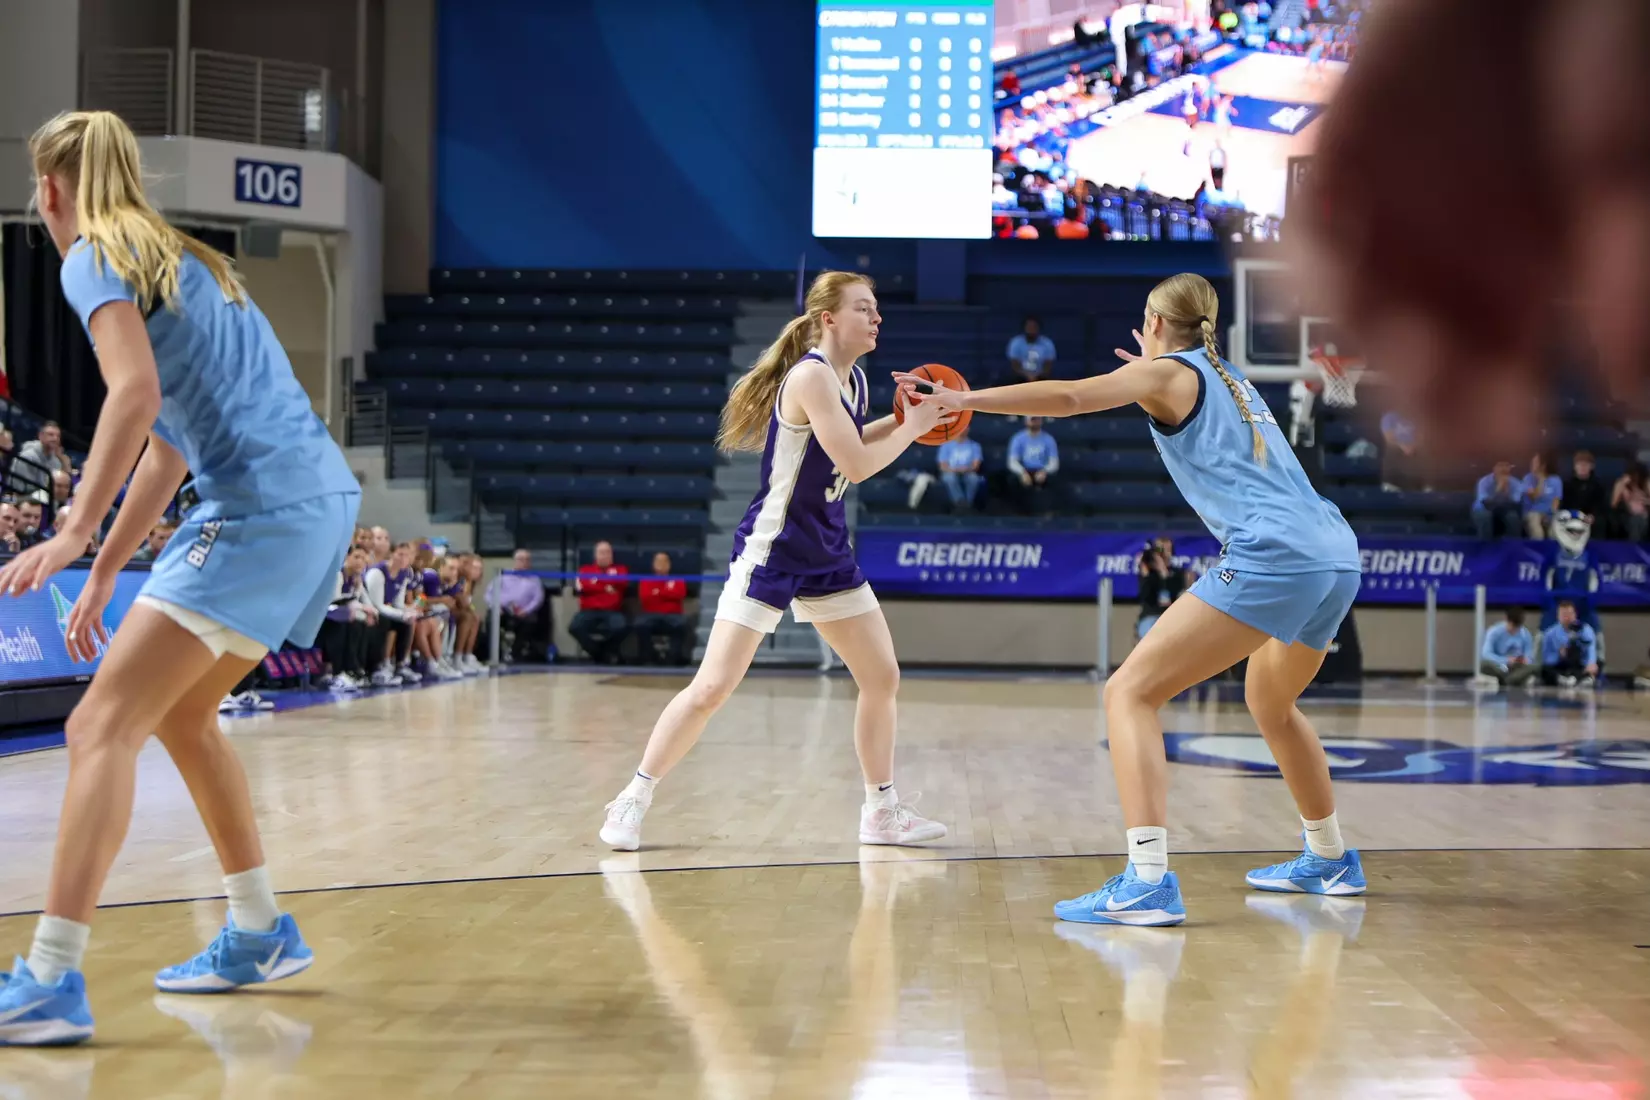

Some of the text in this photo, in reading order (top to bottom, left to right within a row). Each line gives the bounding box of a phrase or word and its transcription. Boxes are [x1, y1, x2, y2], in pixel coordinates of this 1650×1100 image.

[238, 164, 298, 204] 106
[824, 465, 850, 503] 3
[897, 541, 1043, 568] CREIGHTON
[1360, 549, 1465, 576] EIGHTON
[1518, 561, 1541, 582] TH
